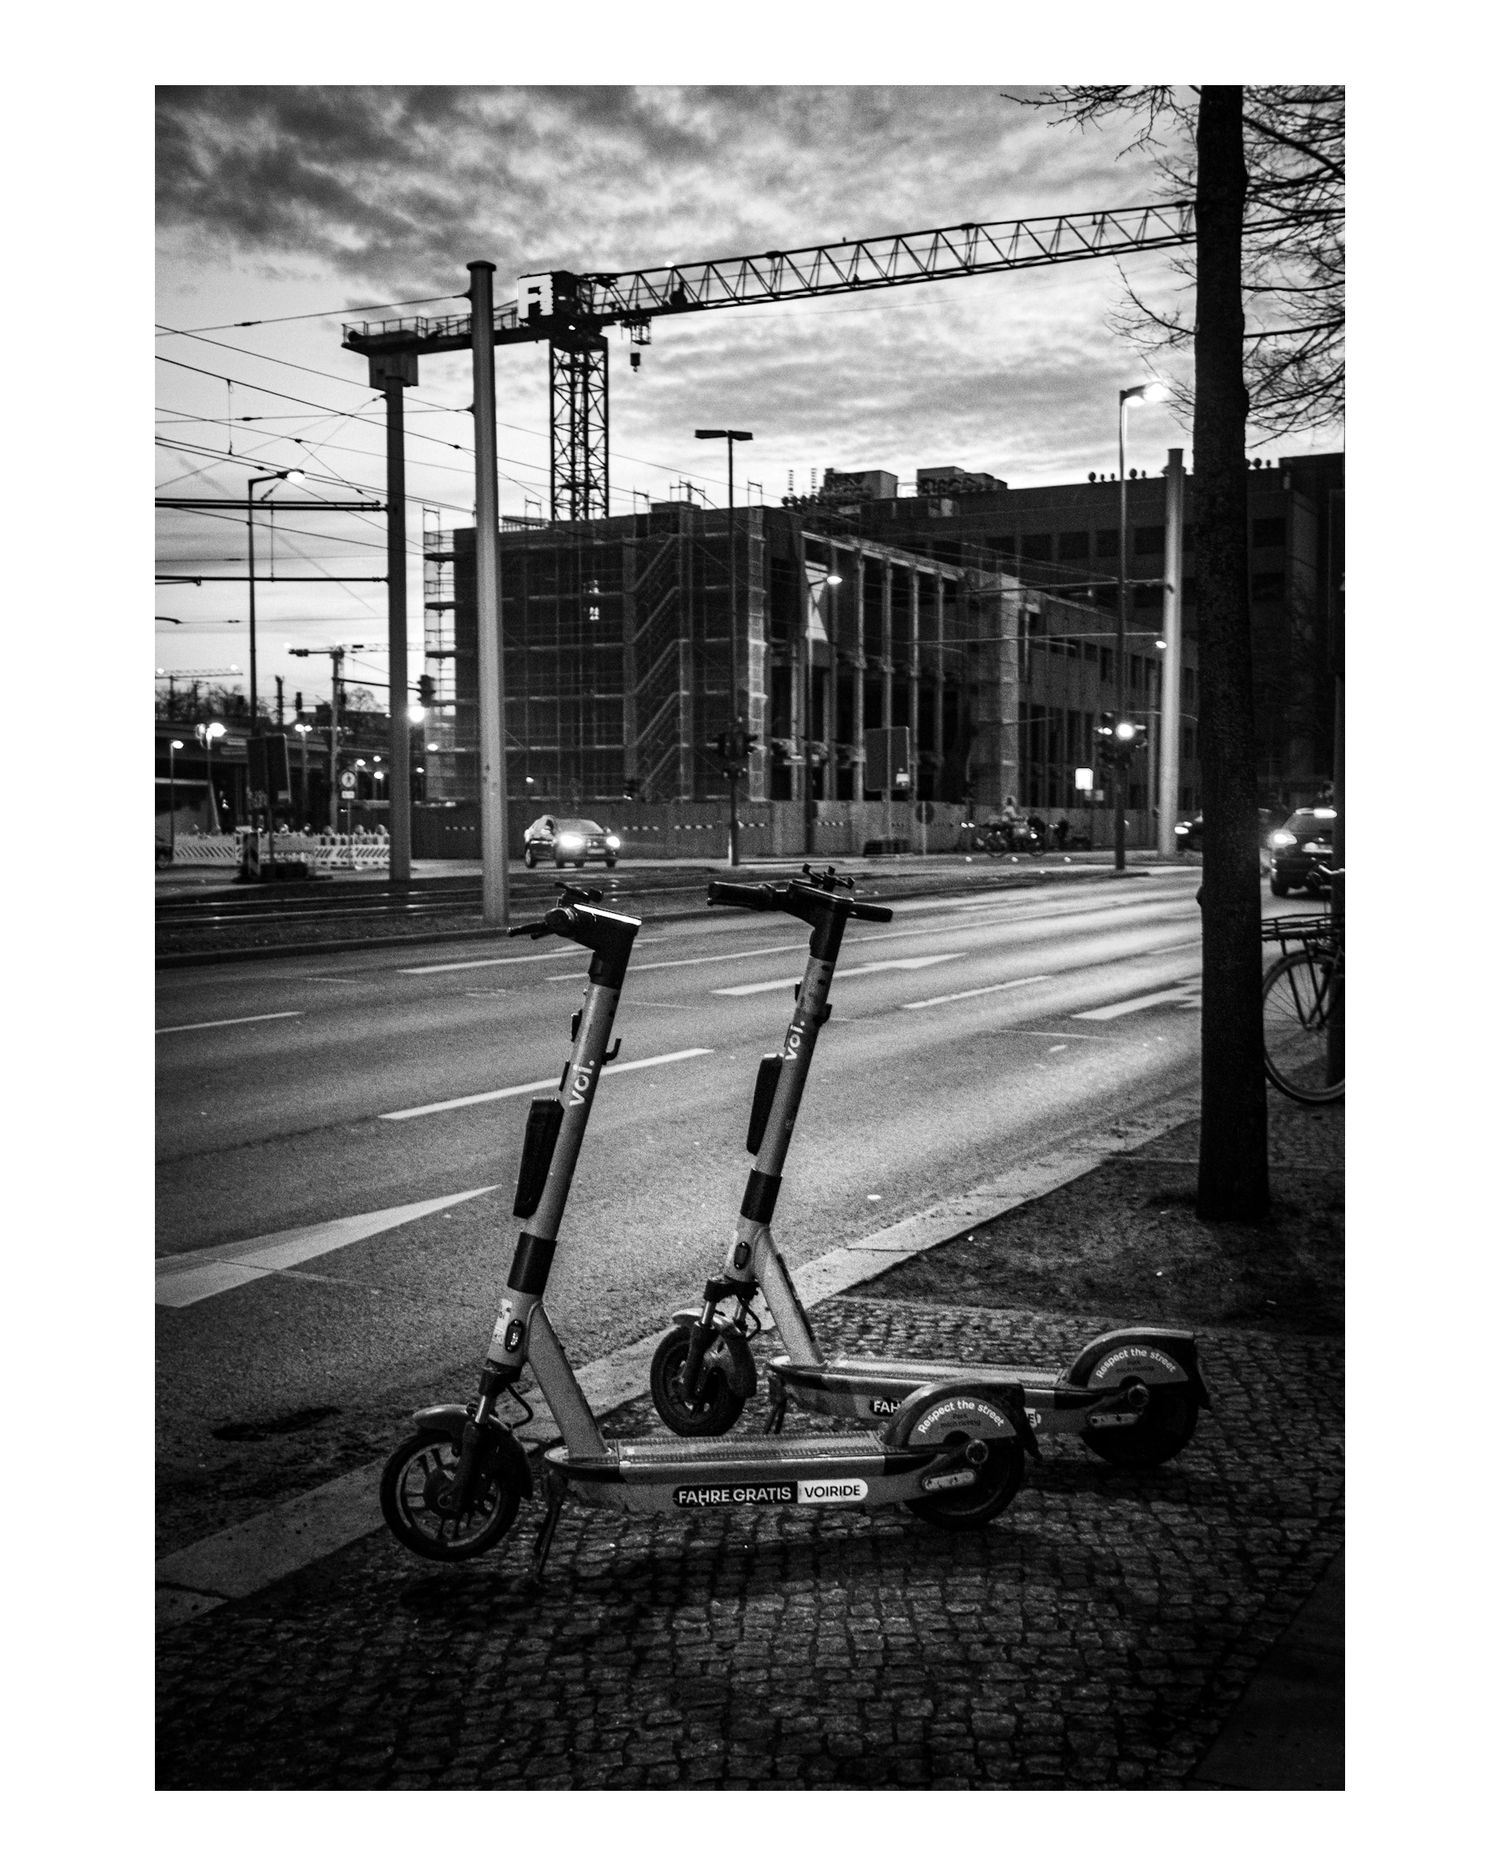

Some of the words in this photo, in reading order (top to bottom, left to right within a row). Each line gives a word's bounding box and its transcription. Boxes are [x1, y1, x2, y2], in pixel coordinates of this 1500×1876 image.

[785, 1021, 805, 1060] voi.
[569, 1060, 595, 1106] voi.
[1095, 1349, 1129, 1379] Respect
[1130, 1348, 1148, 1357] the
[1149, 1351, 1177, 1373] street
[917, 1402, 956, 1433] Respect
[957, 1400, 976, 1410] the
[977, 1404, 1005, 1427] street
[678, 1488, 731, 1504] FAHRE
[732, 1486, 792, 1502] GRATIS
[804, 1485, 861, 1499] VOIRIDE
